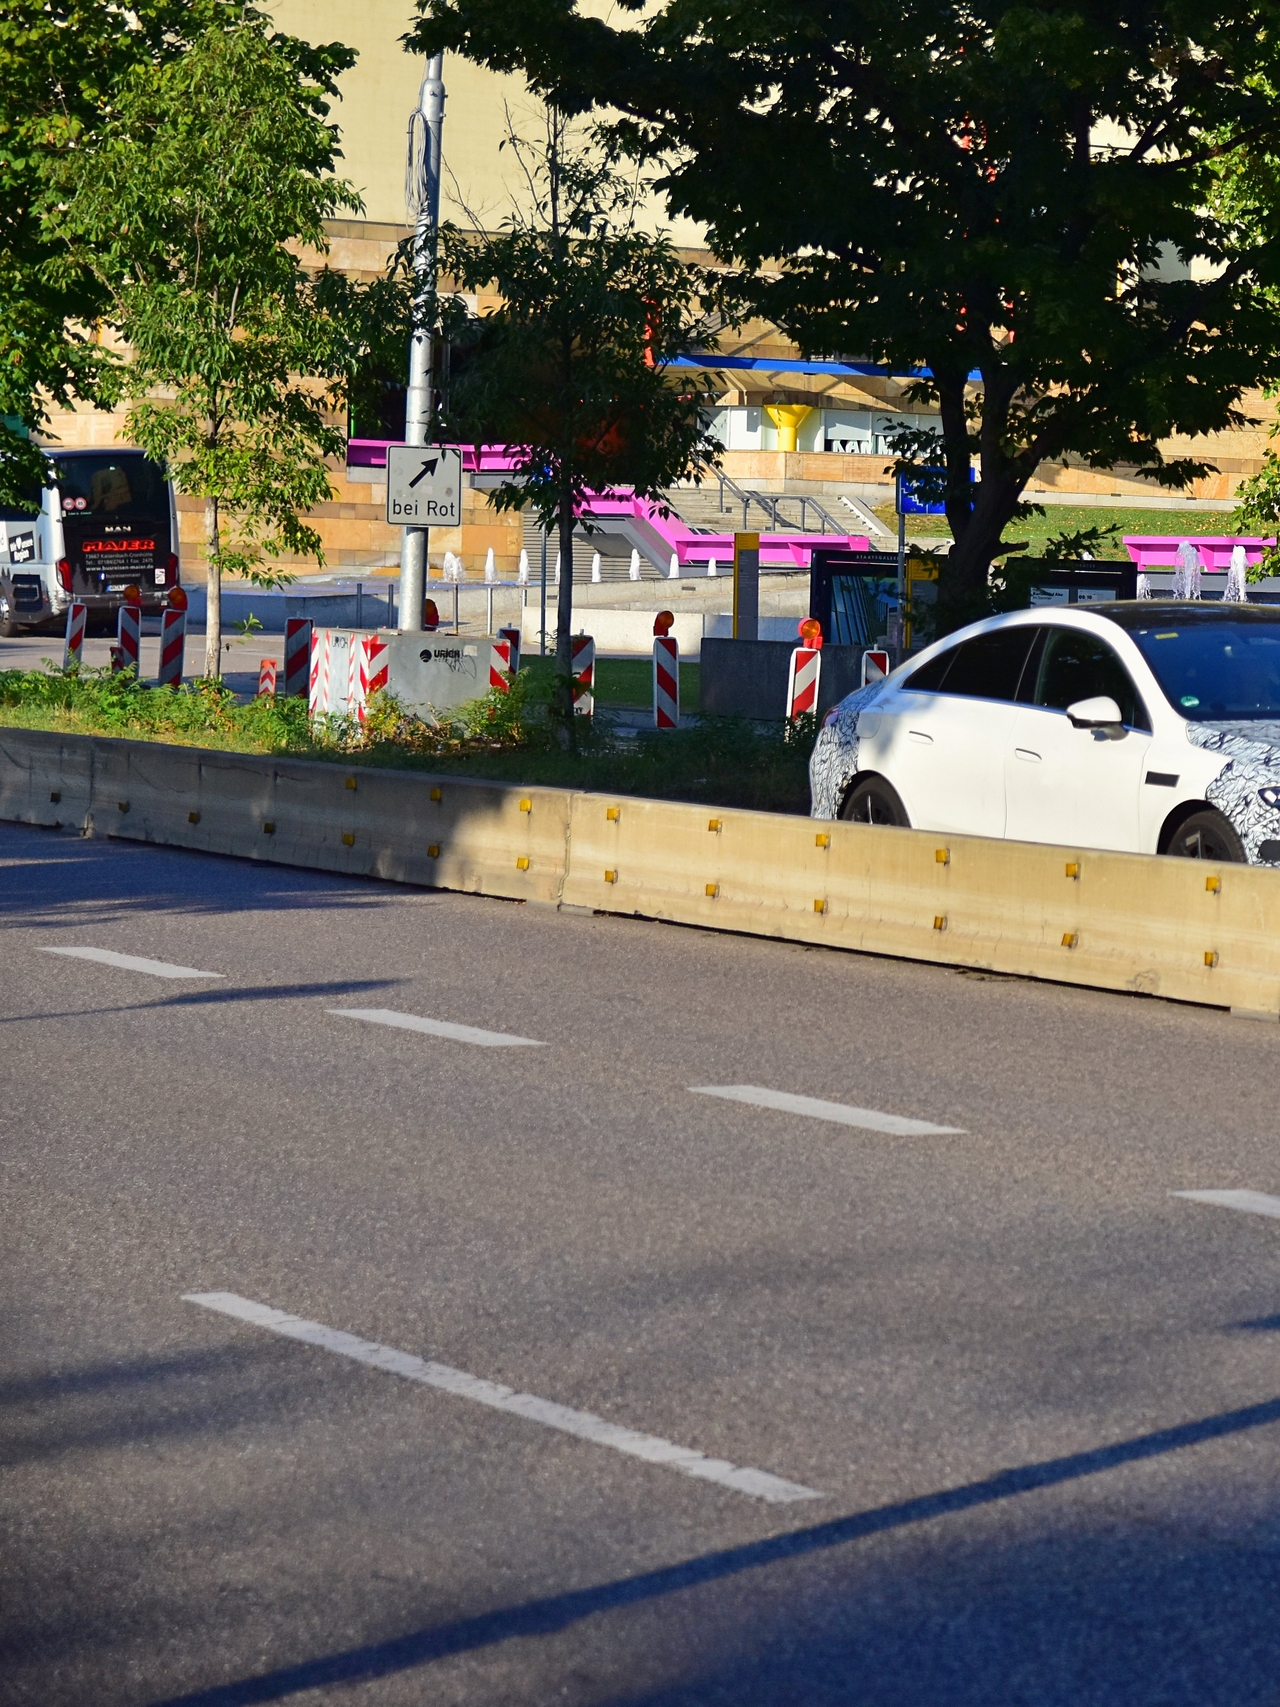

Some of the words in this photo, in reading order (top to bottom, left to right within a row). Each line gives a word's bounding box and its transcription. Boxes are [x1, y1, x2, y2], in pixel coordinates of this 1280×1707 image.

[392, 499, 418, 516] bei
[427, 500, 455, 517] Rot
[104, 525, 131, 533] MAN
[82, 539, 155, 552] MAIER
